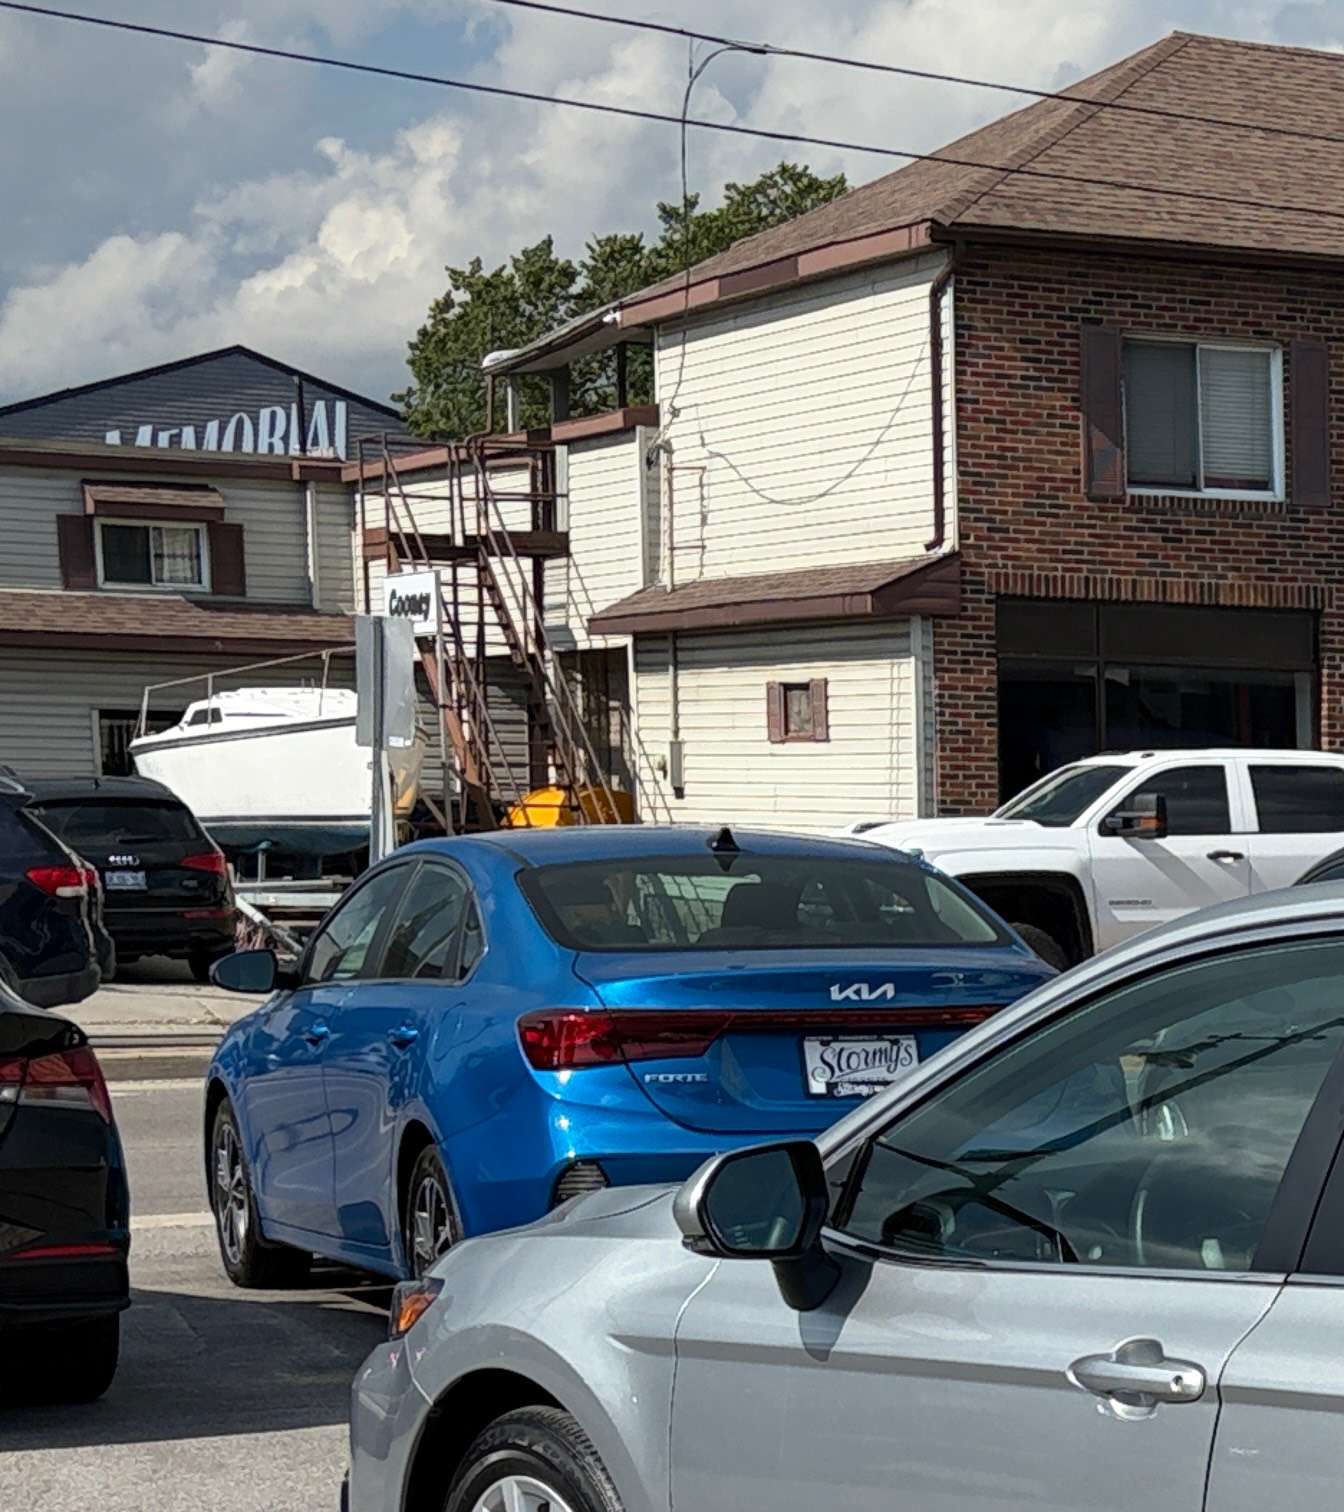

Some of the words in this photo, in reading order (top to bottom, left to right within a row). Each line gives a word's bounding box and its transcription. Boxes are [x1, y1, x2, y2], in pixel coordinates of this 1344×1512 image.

[830, 982, 895, 1000] KIA
[811, 1044, 913, 1084] Stormy's
[644, 1073, 708, 1083] FORTE
